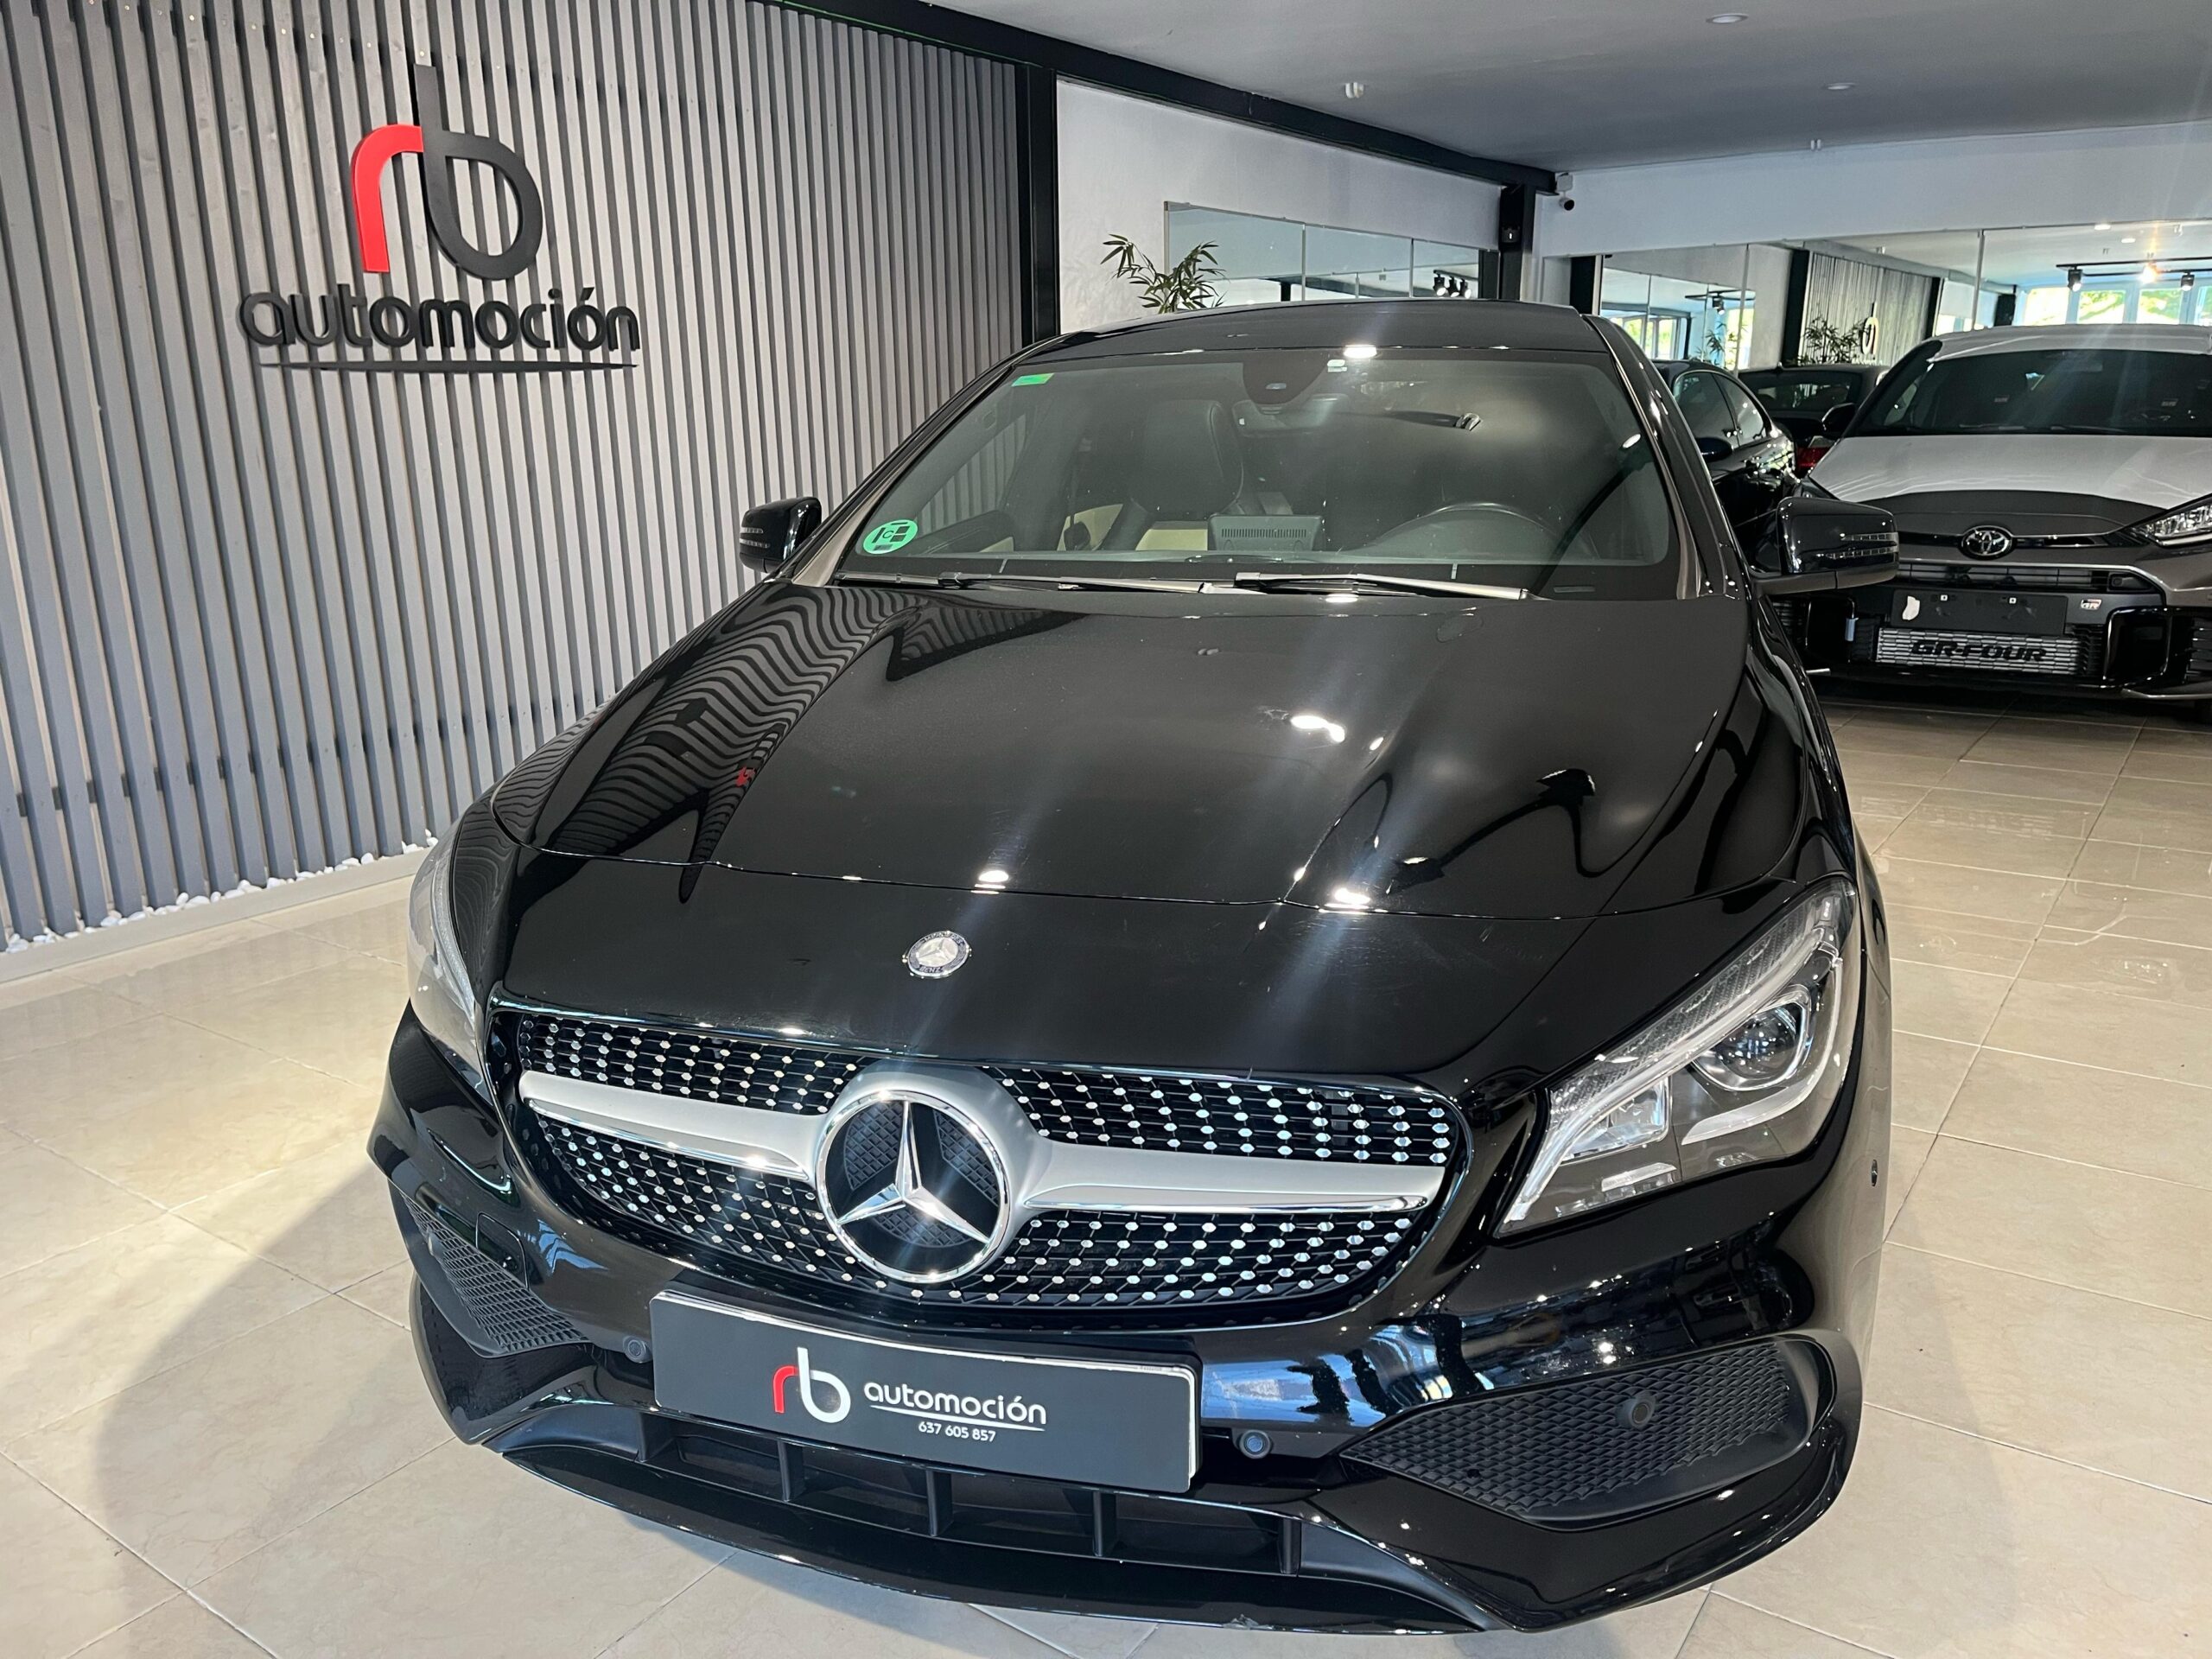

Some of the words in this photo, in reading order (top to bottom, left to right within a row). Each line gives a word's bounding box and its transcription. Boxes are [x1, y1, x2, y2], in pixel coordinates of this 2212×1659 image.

[352, 63, 543, 281] rb
[239, 283, 640, 351] automoción
[1911, 640, 2047, 662] GR-FOUR
[772, 1347, 851, 1423] rb
[864, 1382, 1046, 1424] automoción
[918, 1421, 942, 1434] 637
[945, 1425, 969, 1439] 605
[972, 1429, 996, 1442] 857
